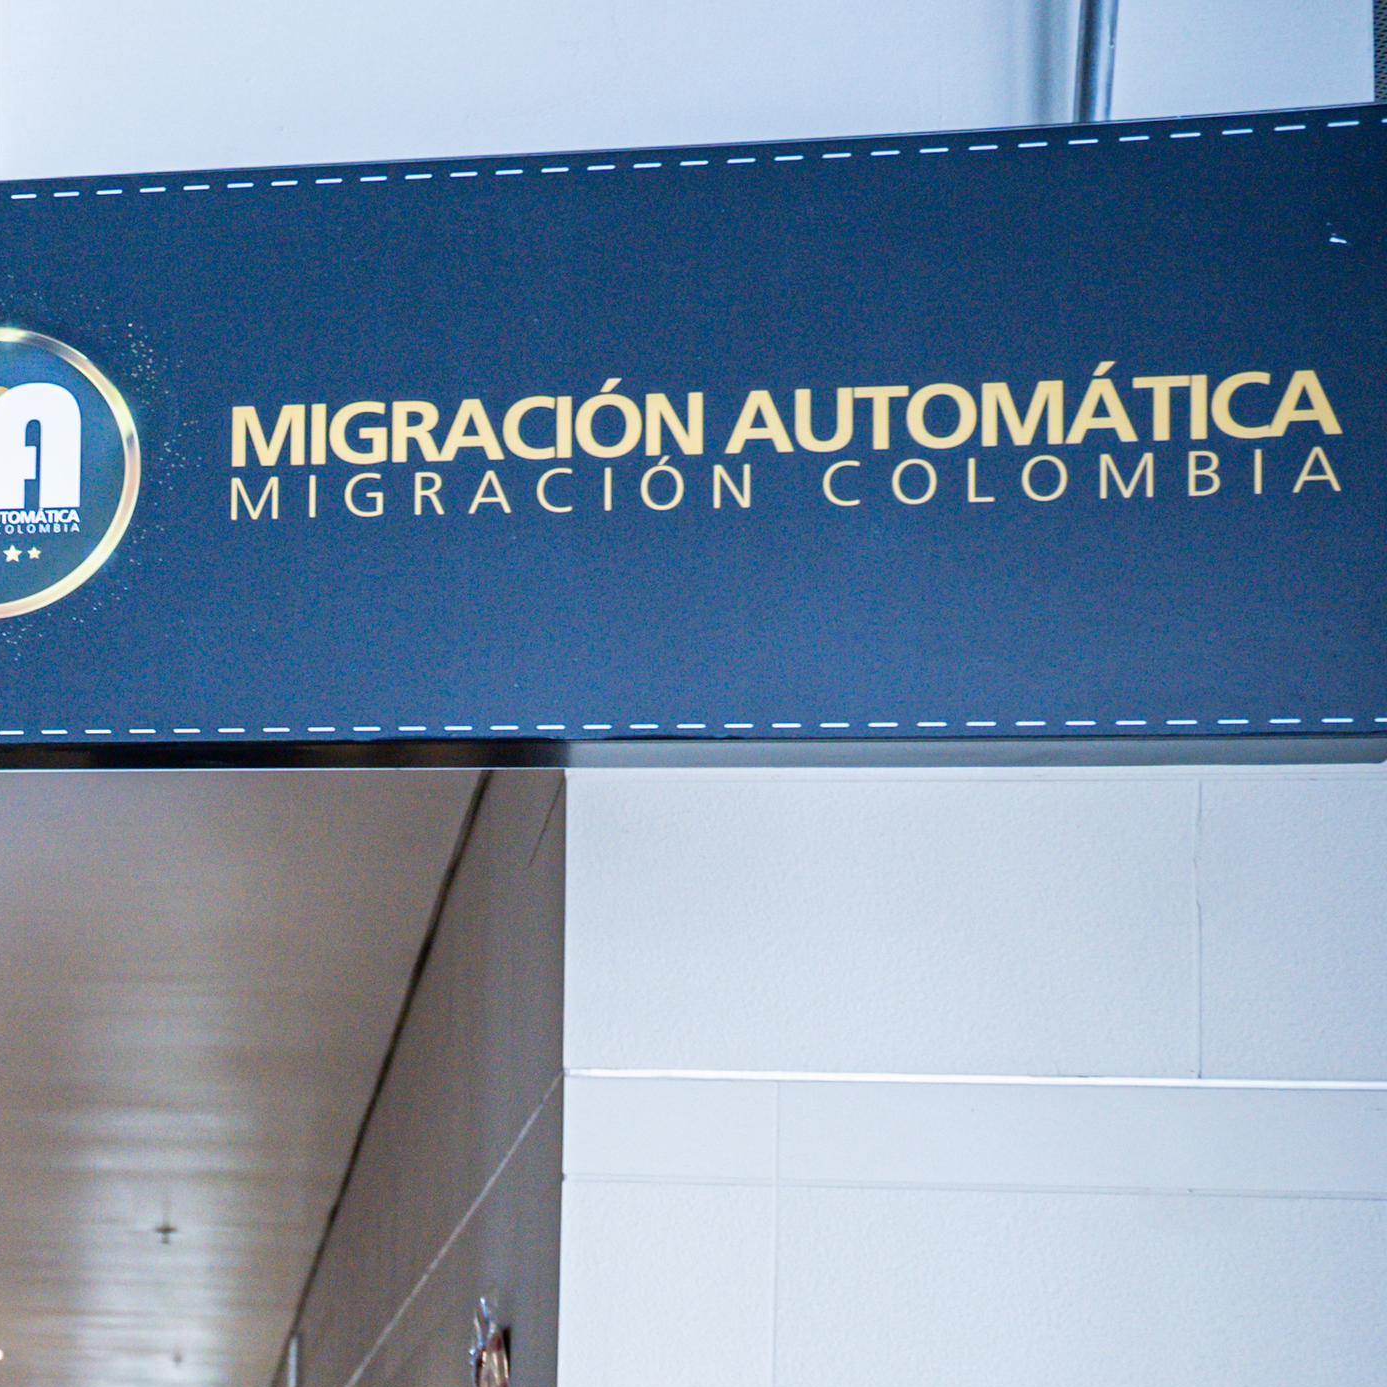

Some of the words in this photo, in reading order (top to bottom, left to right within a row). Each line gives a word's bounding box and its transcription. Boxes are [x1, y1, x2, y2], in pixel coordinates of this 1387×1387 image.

[230, 377, 704, 468] MIGRACIÓN
[724, 361, 1344, 456] AUTOMÁTICA
[230, 454, 752, 521] MIGRACIÓN
[822, 445, 1343, 508] COLOMBIA
